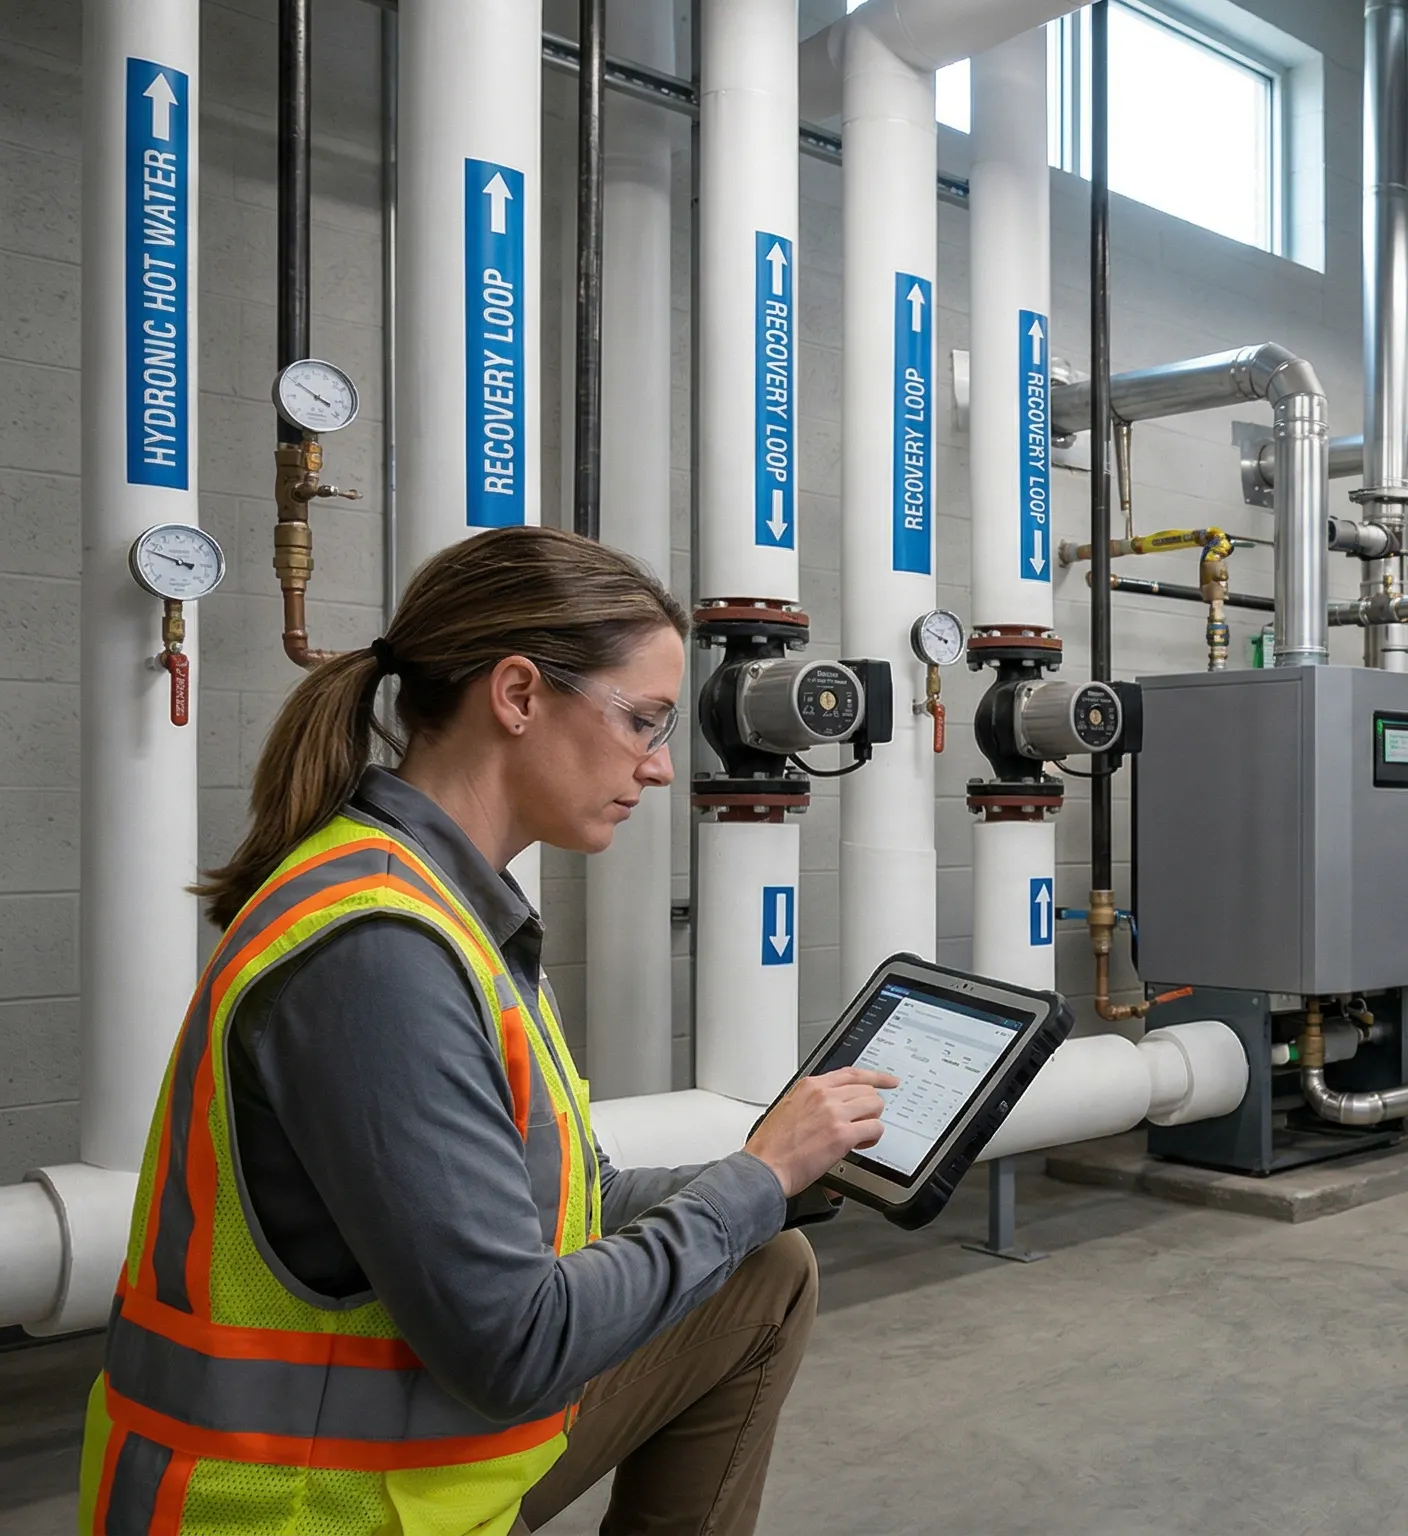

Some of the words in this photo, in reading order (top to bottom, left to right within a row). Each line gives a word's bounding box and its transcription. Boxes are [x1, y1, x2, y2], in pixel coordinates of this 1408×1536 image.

[143, 149, 177, 246] WATER
[143, 252, 177, 313] HOT
[483, 268, 514, 343] LOOP
[143, 319, 177, 467] HYDRONIC
[765, 299, 788, 420] RECOVERY
[904, 367, 925, 422] LOOP
[483, 349, 514, 495] RECOVERY
[765, 423, 788, 483] LOOP
[1027, 371, 1045, 472] RECOVERY
[904, 426, 924, 531] RECOVERY
[1029, 476, 1046, 525] LOOP
